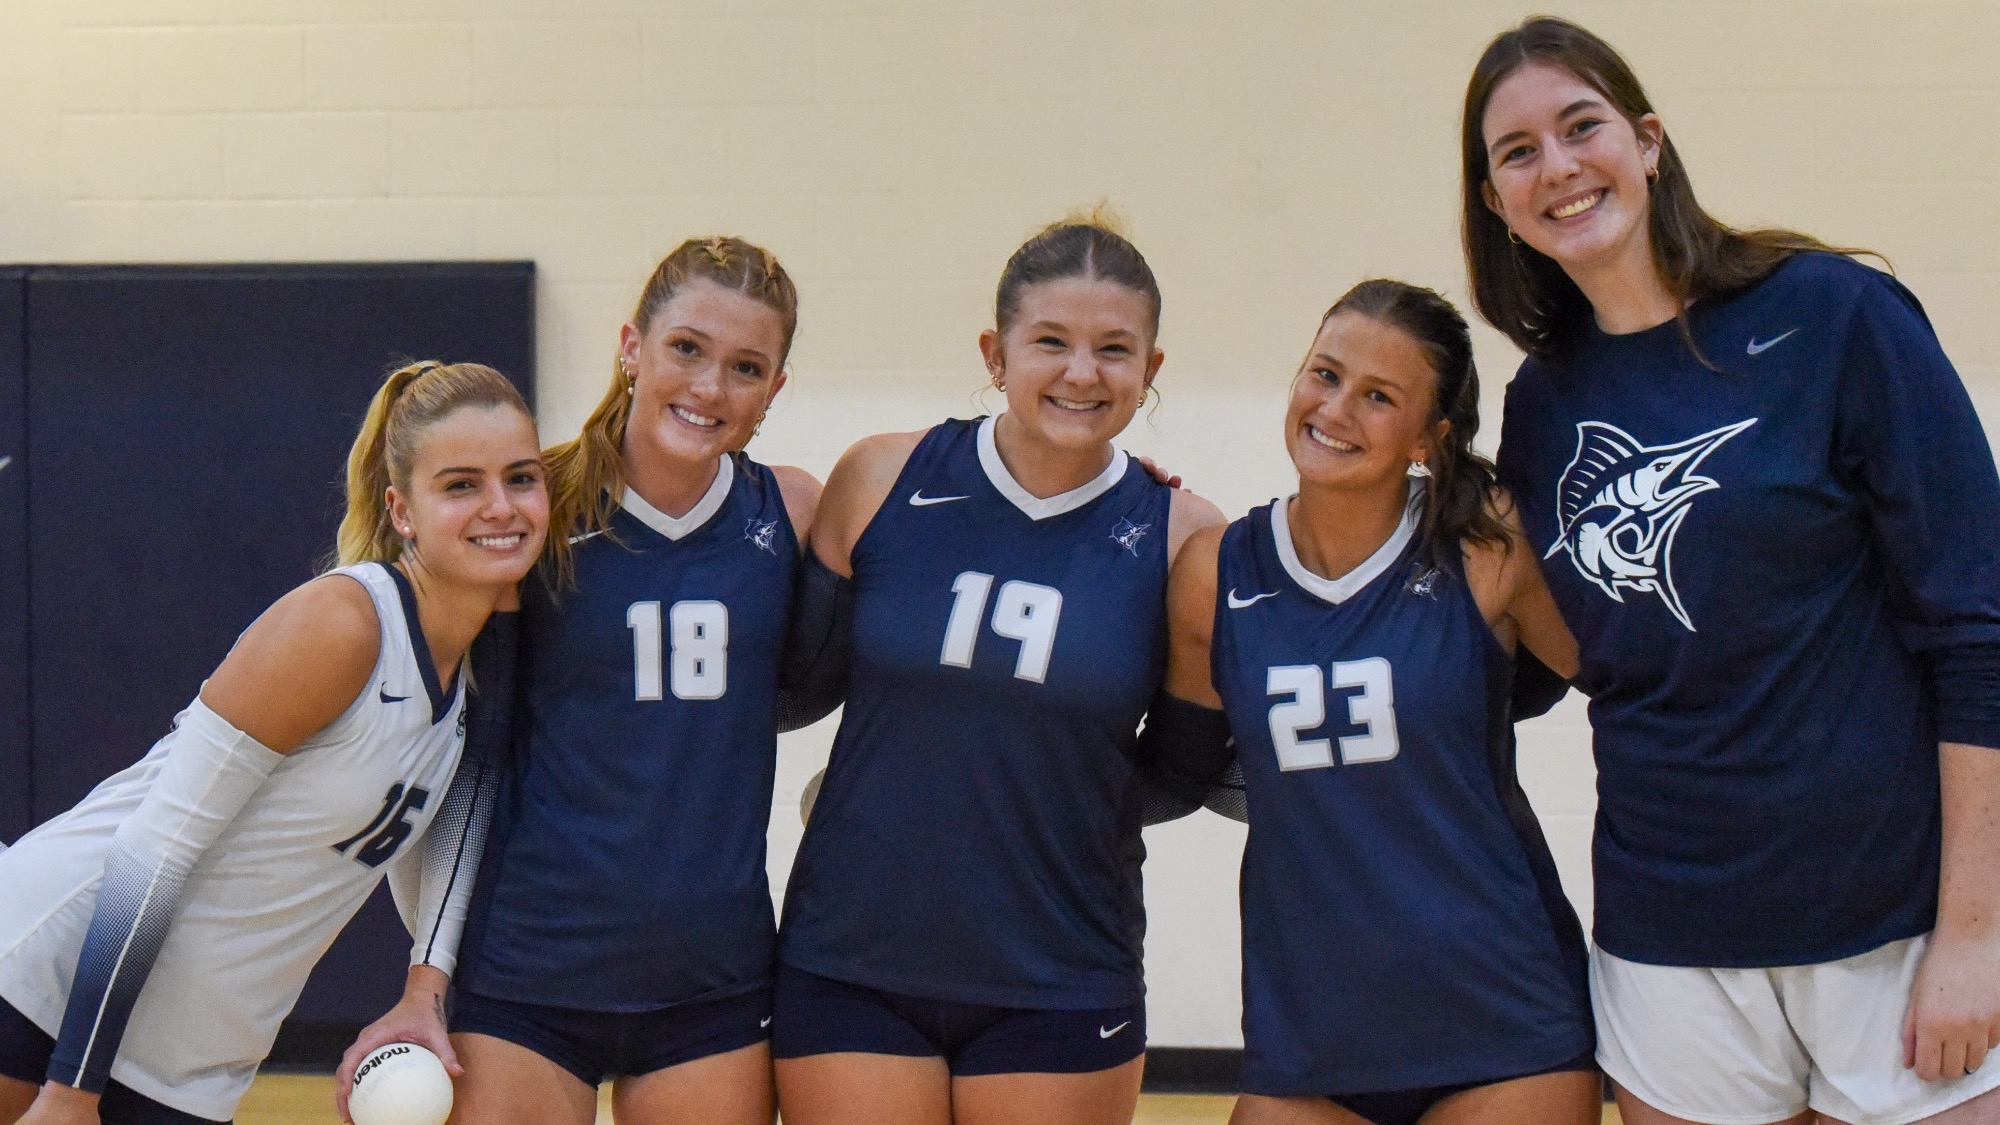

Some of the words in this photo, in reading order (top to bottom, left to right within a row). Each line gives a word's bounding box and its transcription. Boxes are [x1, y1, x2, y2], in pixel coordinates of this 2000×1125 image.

[627, 600, 728, 701] 18
[940, 571, 1063, 684] 19
[1267, 657, 1399, 772] 23
[354, 1046, 410, 1086] molten
